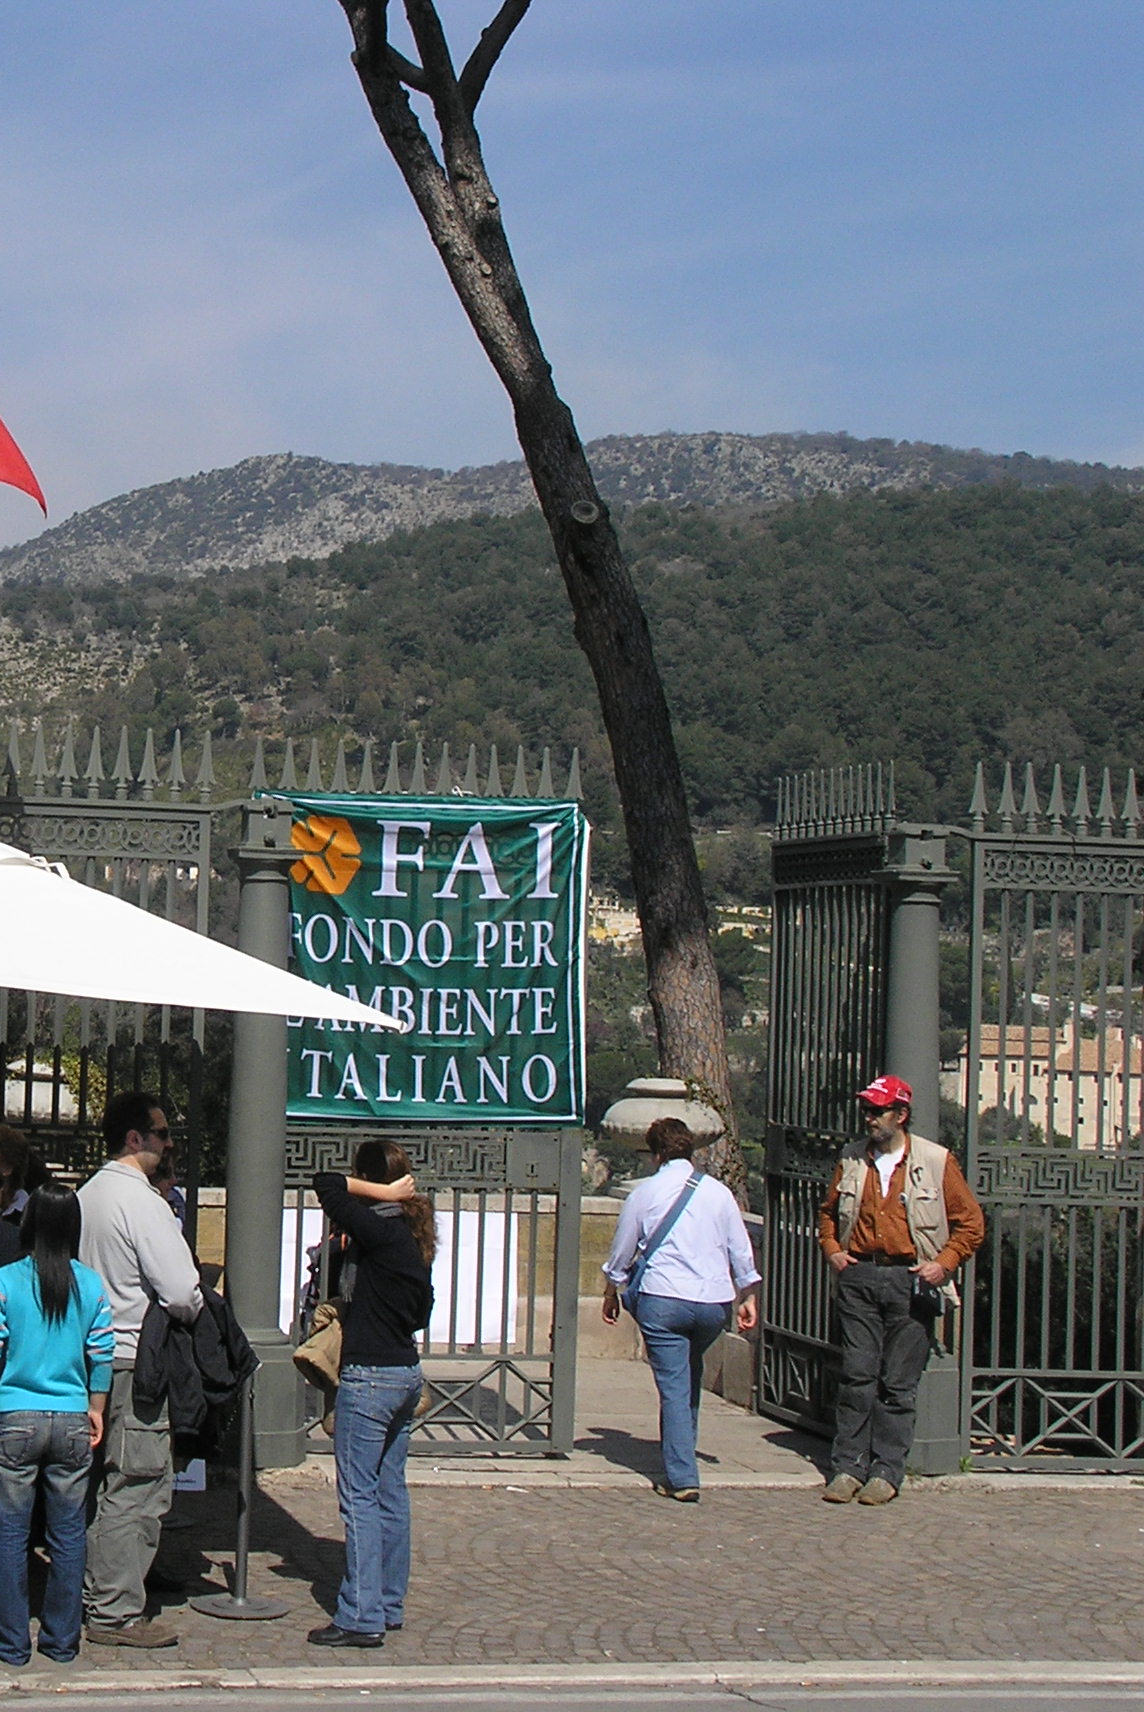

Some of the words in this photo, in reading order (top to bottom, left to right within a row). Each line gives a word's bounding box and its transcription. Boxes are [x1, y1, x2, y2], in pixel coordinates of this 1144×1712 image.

[371, 818, 562, 900] FAI
[288, 912, 453, 969] FONDO
[474, 919, 559, 968] PER
[286, 980, 558, 1036] MBIENTE
[286, 1048, 558, 1104] TALIANO
